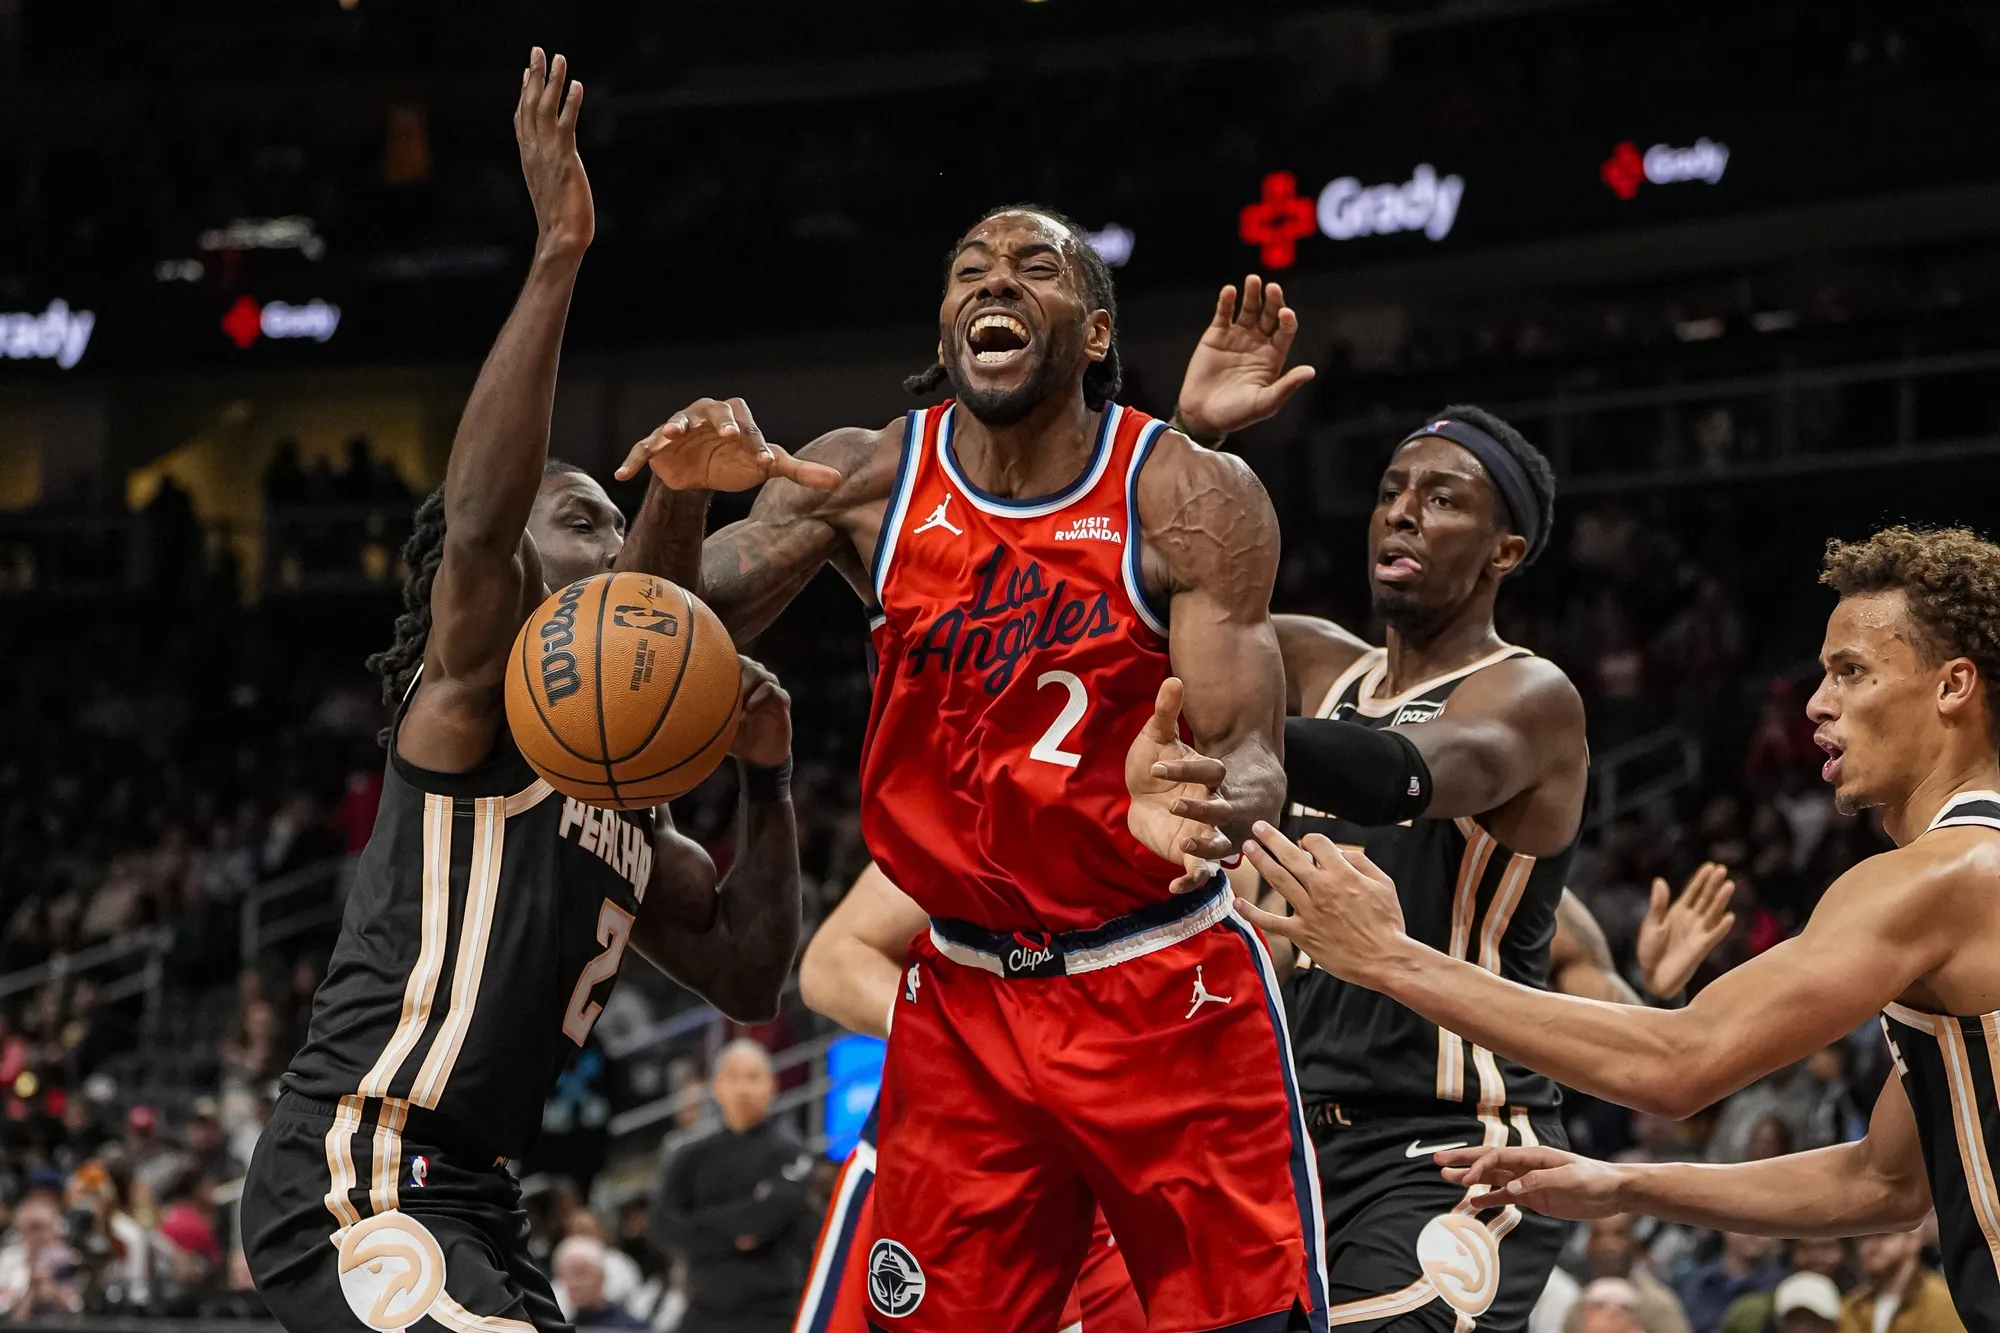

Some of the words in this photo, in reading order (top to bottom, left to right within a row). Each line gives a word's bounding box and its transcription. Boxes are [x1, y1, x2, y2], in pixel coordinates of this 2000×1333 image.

[1318, 164, 1463, 240] Grady
[1054, 528, 1121, 544] RWANDA
[1073, 516, 1110, 530] VISIT
[968, 543, 1049, 620] Los
[1029, 670, 1088, 768] 2
[1396, 709, 1434, 726] paz
[562, 897, 636, 1048] 2
[1008, 947, 1055, 972] Clips
